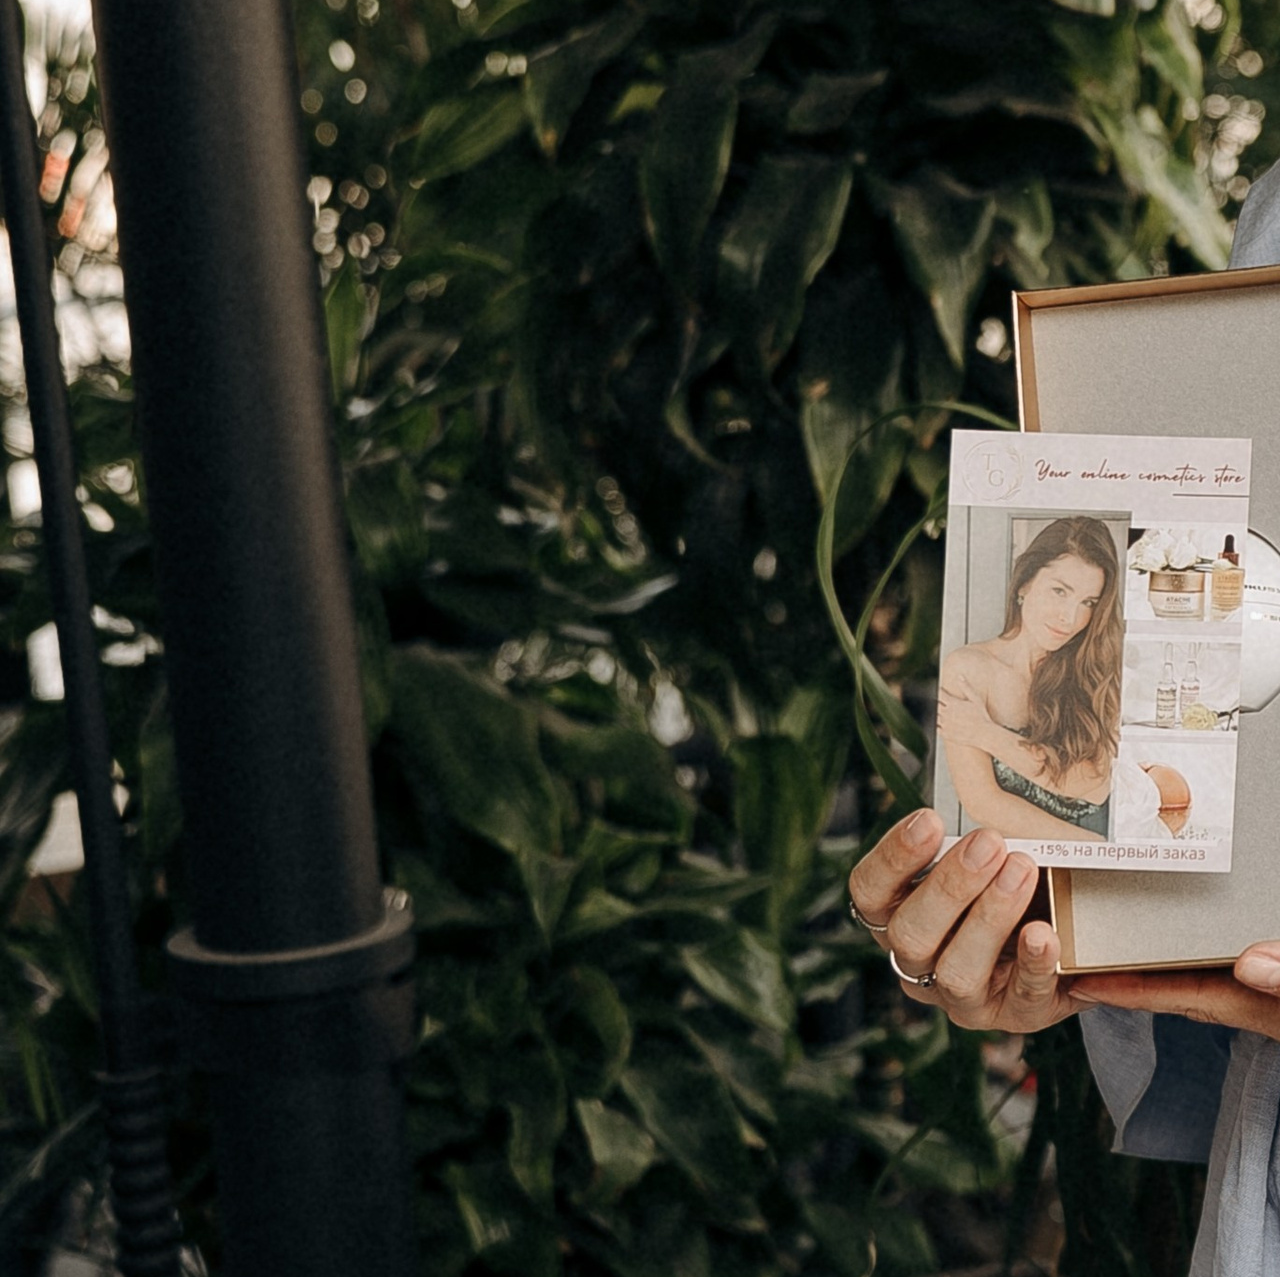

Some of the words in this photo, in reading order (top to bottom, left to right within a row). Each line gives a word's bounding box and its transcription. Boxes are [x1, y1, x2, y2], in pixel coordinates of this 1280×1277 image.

[1035, 459, 1071, 482] Your
[1081, 459, 1131, 481] online
[1138, 463, 1205, 487] cosmetics
[1214, 464, 1245, 488] store
[1033, 844, 1069, 857] -15%
[1074, 846, 1092, 857] на
[1098, 844, 1159, 862] первый
[1163, 848, 1206, 861] заказ
